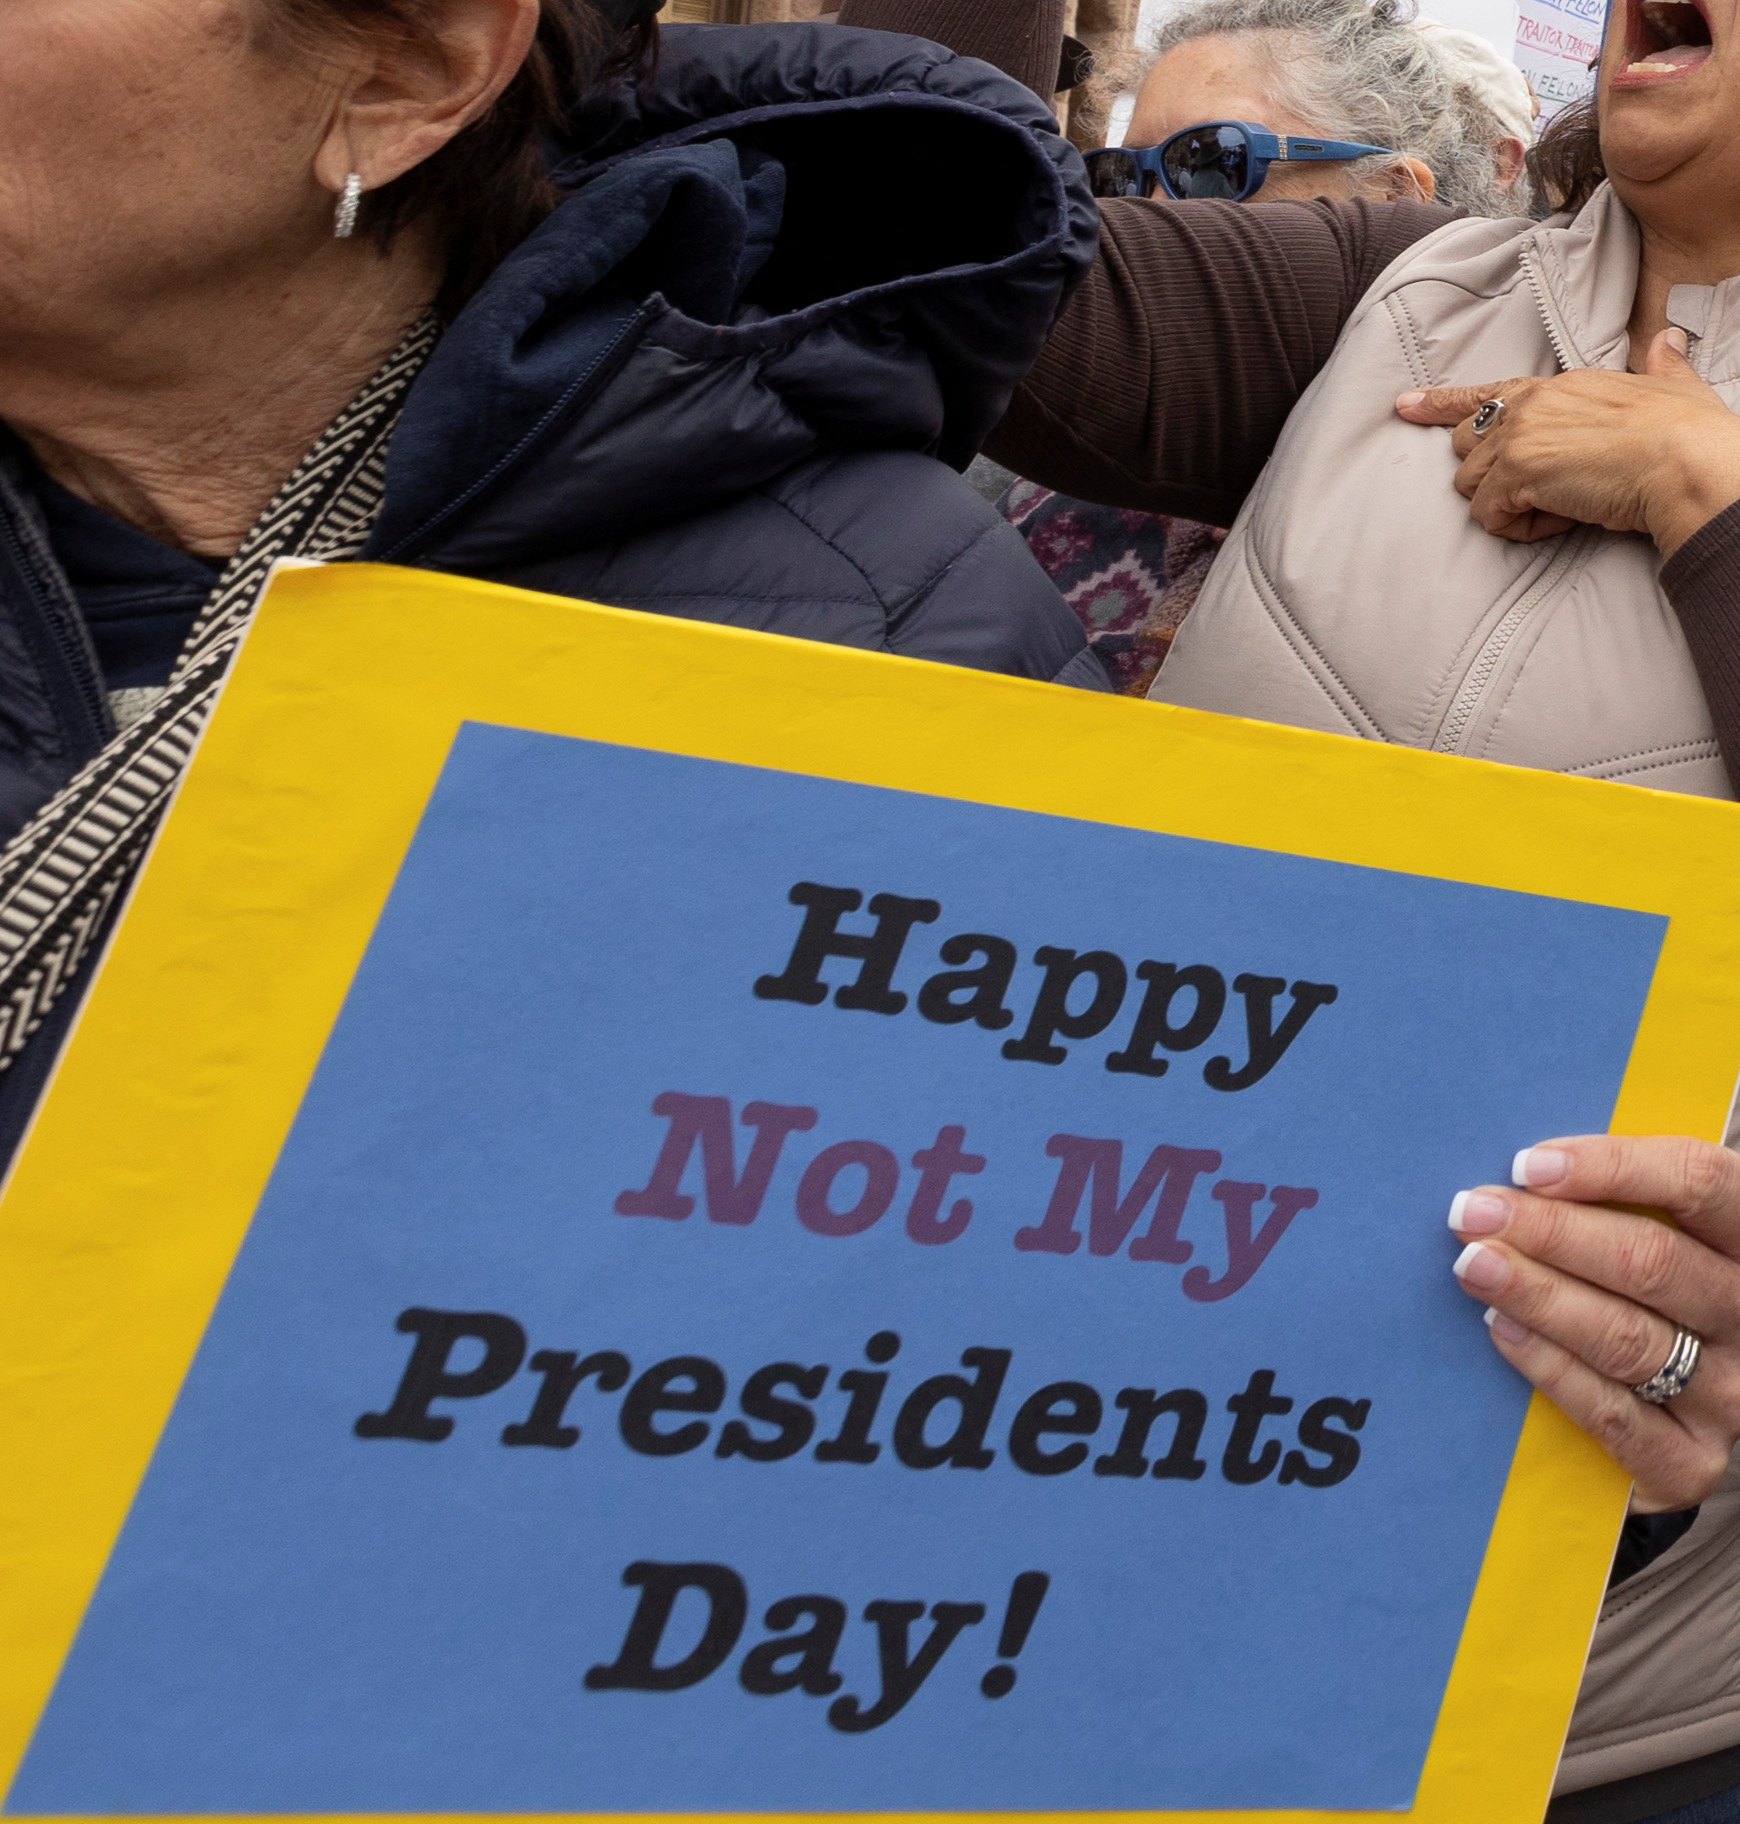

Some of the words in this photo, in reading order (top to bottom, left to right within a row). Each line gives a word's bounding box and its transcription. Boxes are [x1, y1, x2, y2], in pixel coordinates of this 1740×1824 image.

[1517, 15, 1563, 49] TRAITOR
[754, 882, 1337, 1091] Happy
[614, 1091, 987, 1246] Not
[1015, 1133, 1318, 1302] My
[354, 1308, 1370, 1487] Presidents
[582, 1559, 1051, 1734] Day!
